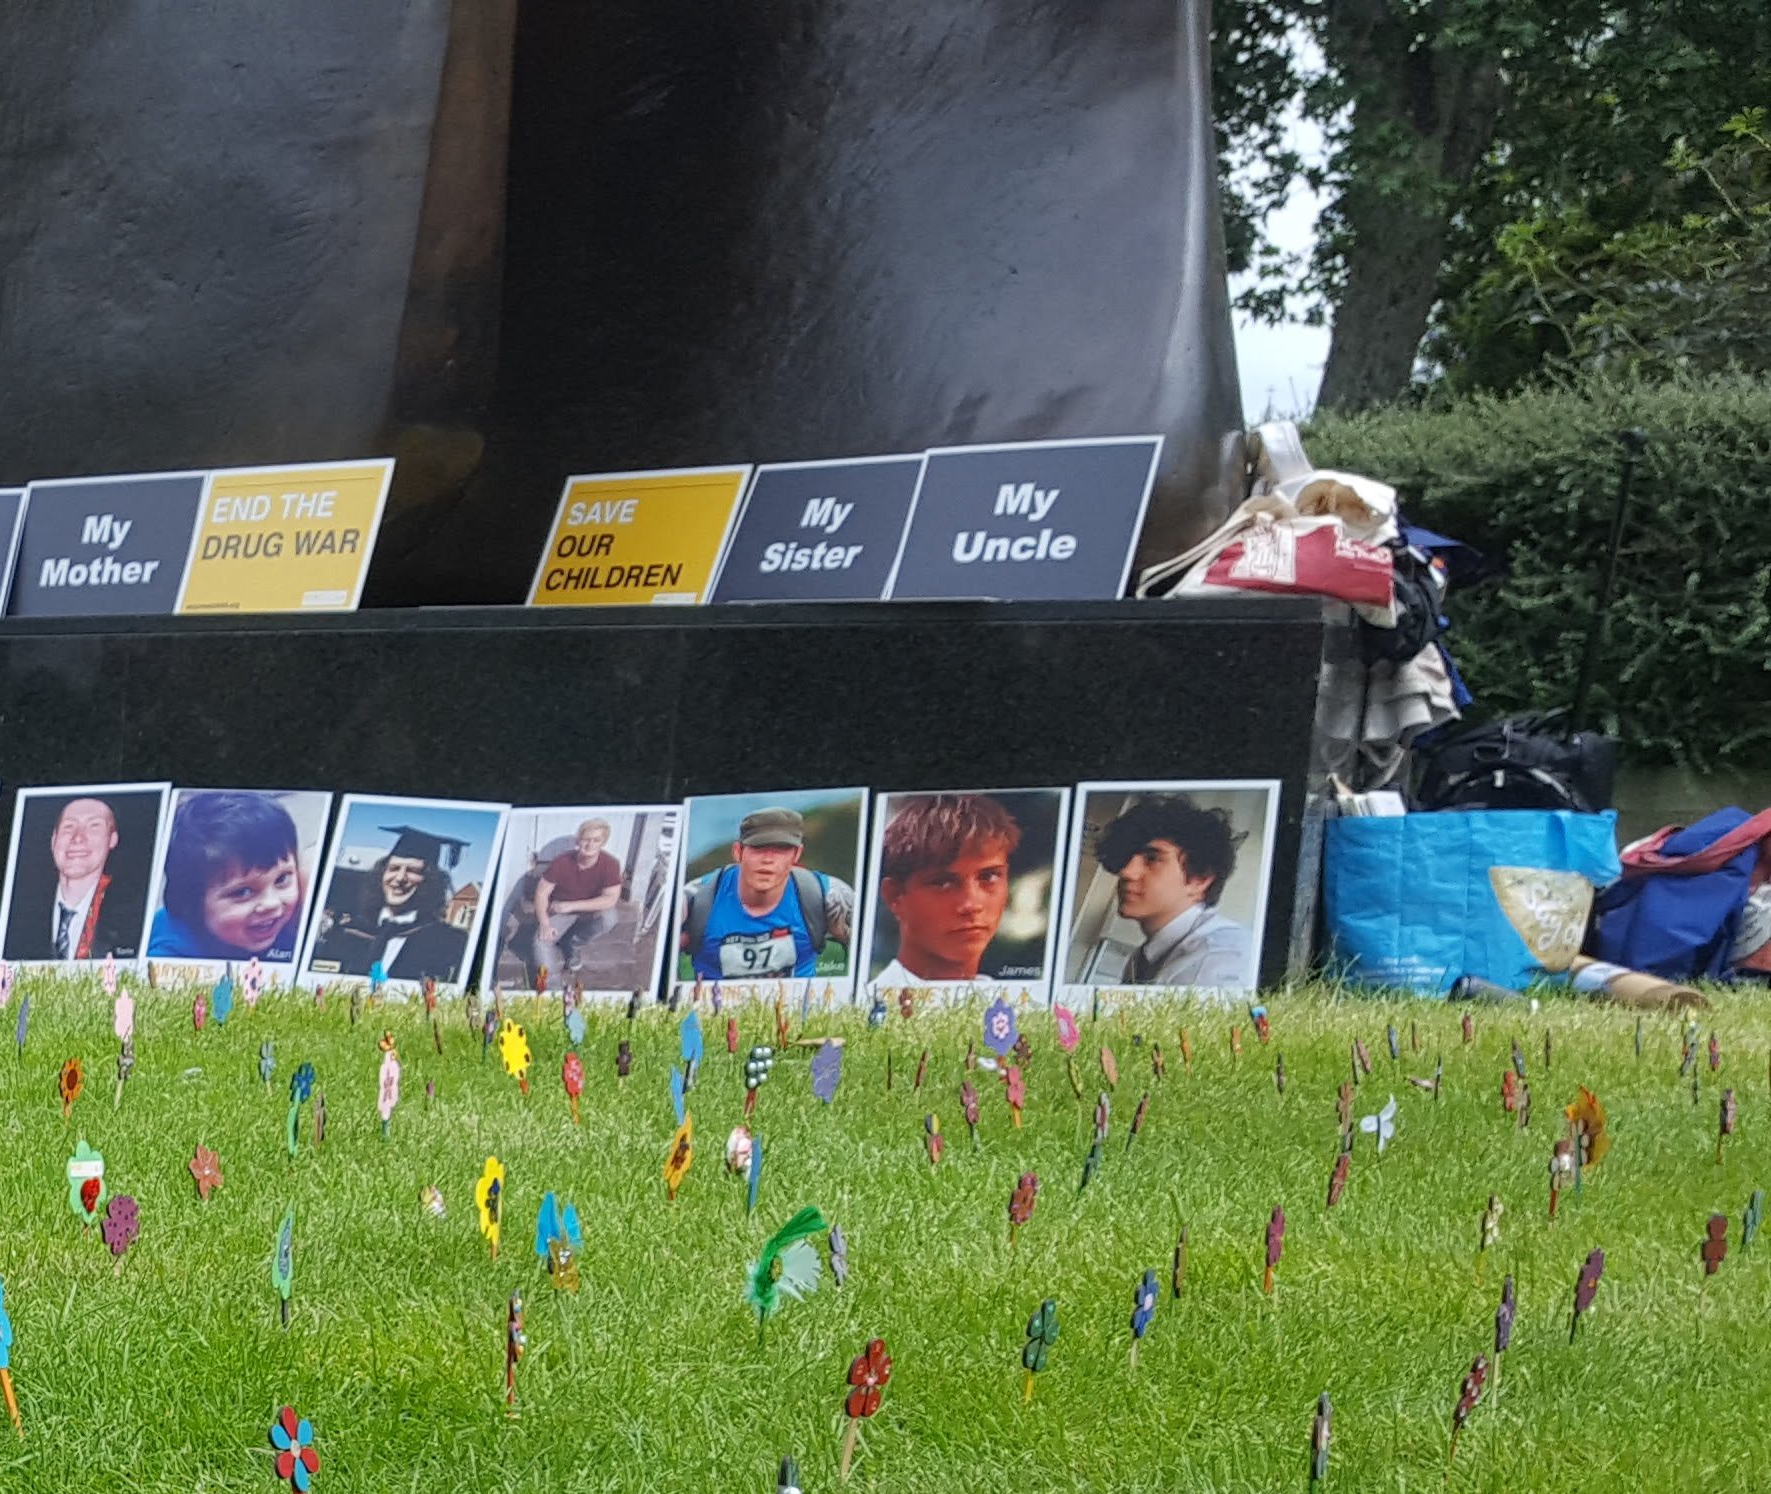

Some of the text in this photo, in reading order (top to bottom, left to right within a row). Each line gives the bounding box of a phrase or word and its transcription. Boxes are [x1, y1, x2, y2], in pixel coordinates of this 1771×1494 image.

[211, 490, 338, 524] END THE
[567, 499, 639, 526] SAVE
[800, 496, 855, 534] My
[993, 482, 1061, 522] My
[81, 513, 133, 551] My
[201, 528, 360, 560] DRUG WAR
[557, 533, 616, 558] OUR
[952, 527, 1077, 563] Uncle
[39, 555, 160, 587] Mother
[760, 541, 864, 574] Sister
[545, 562, 684, 591] CHILDREN
[743, 945, 774, 970] 97
[998, 964, 1042, 978] James
